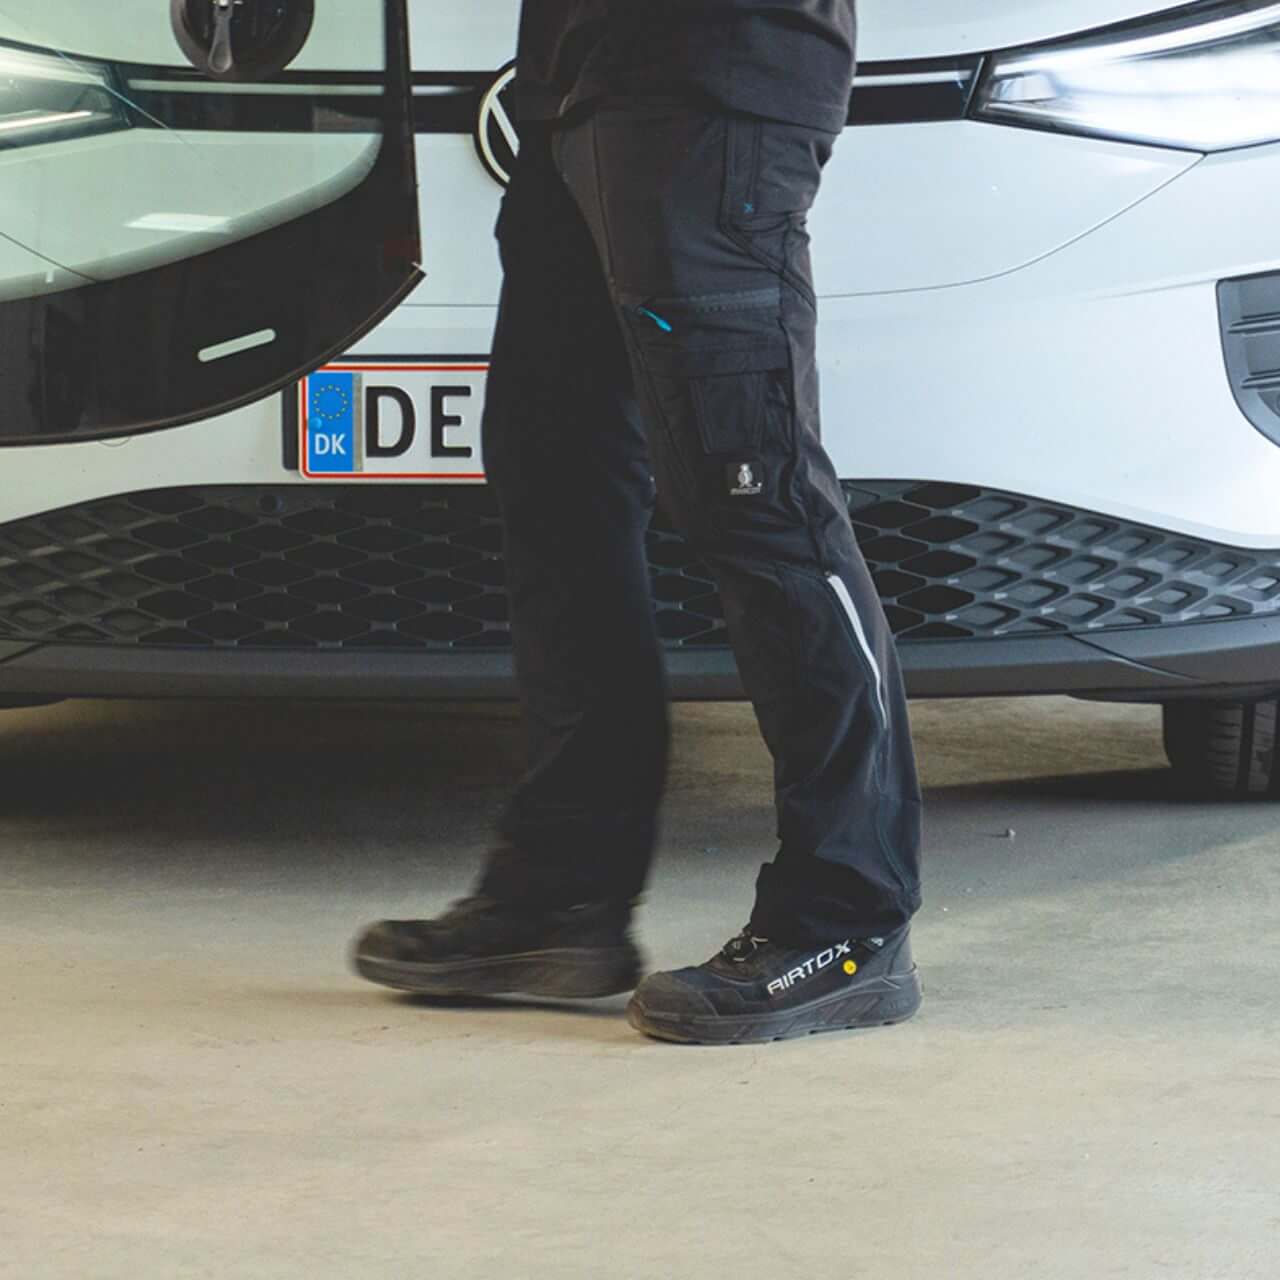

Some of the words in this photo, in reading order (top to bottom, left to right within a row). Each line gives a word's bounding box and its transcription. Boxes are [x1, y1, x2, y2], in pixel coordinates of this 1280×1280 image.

[314, 434, 346, 455] DK
[366, 386, 472, 458] DE
[767, 939, 851, 995] AIRTOX
